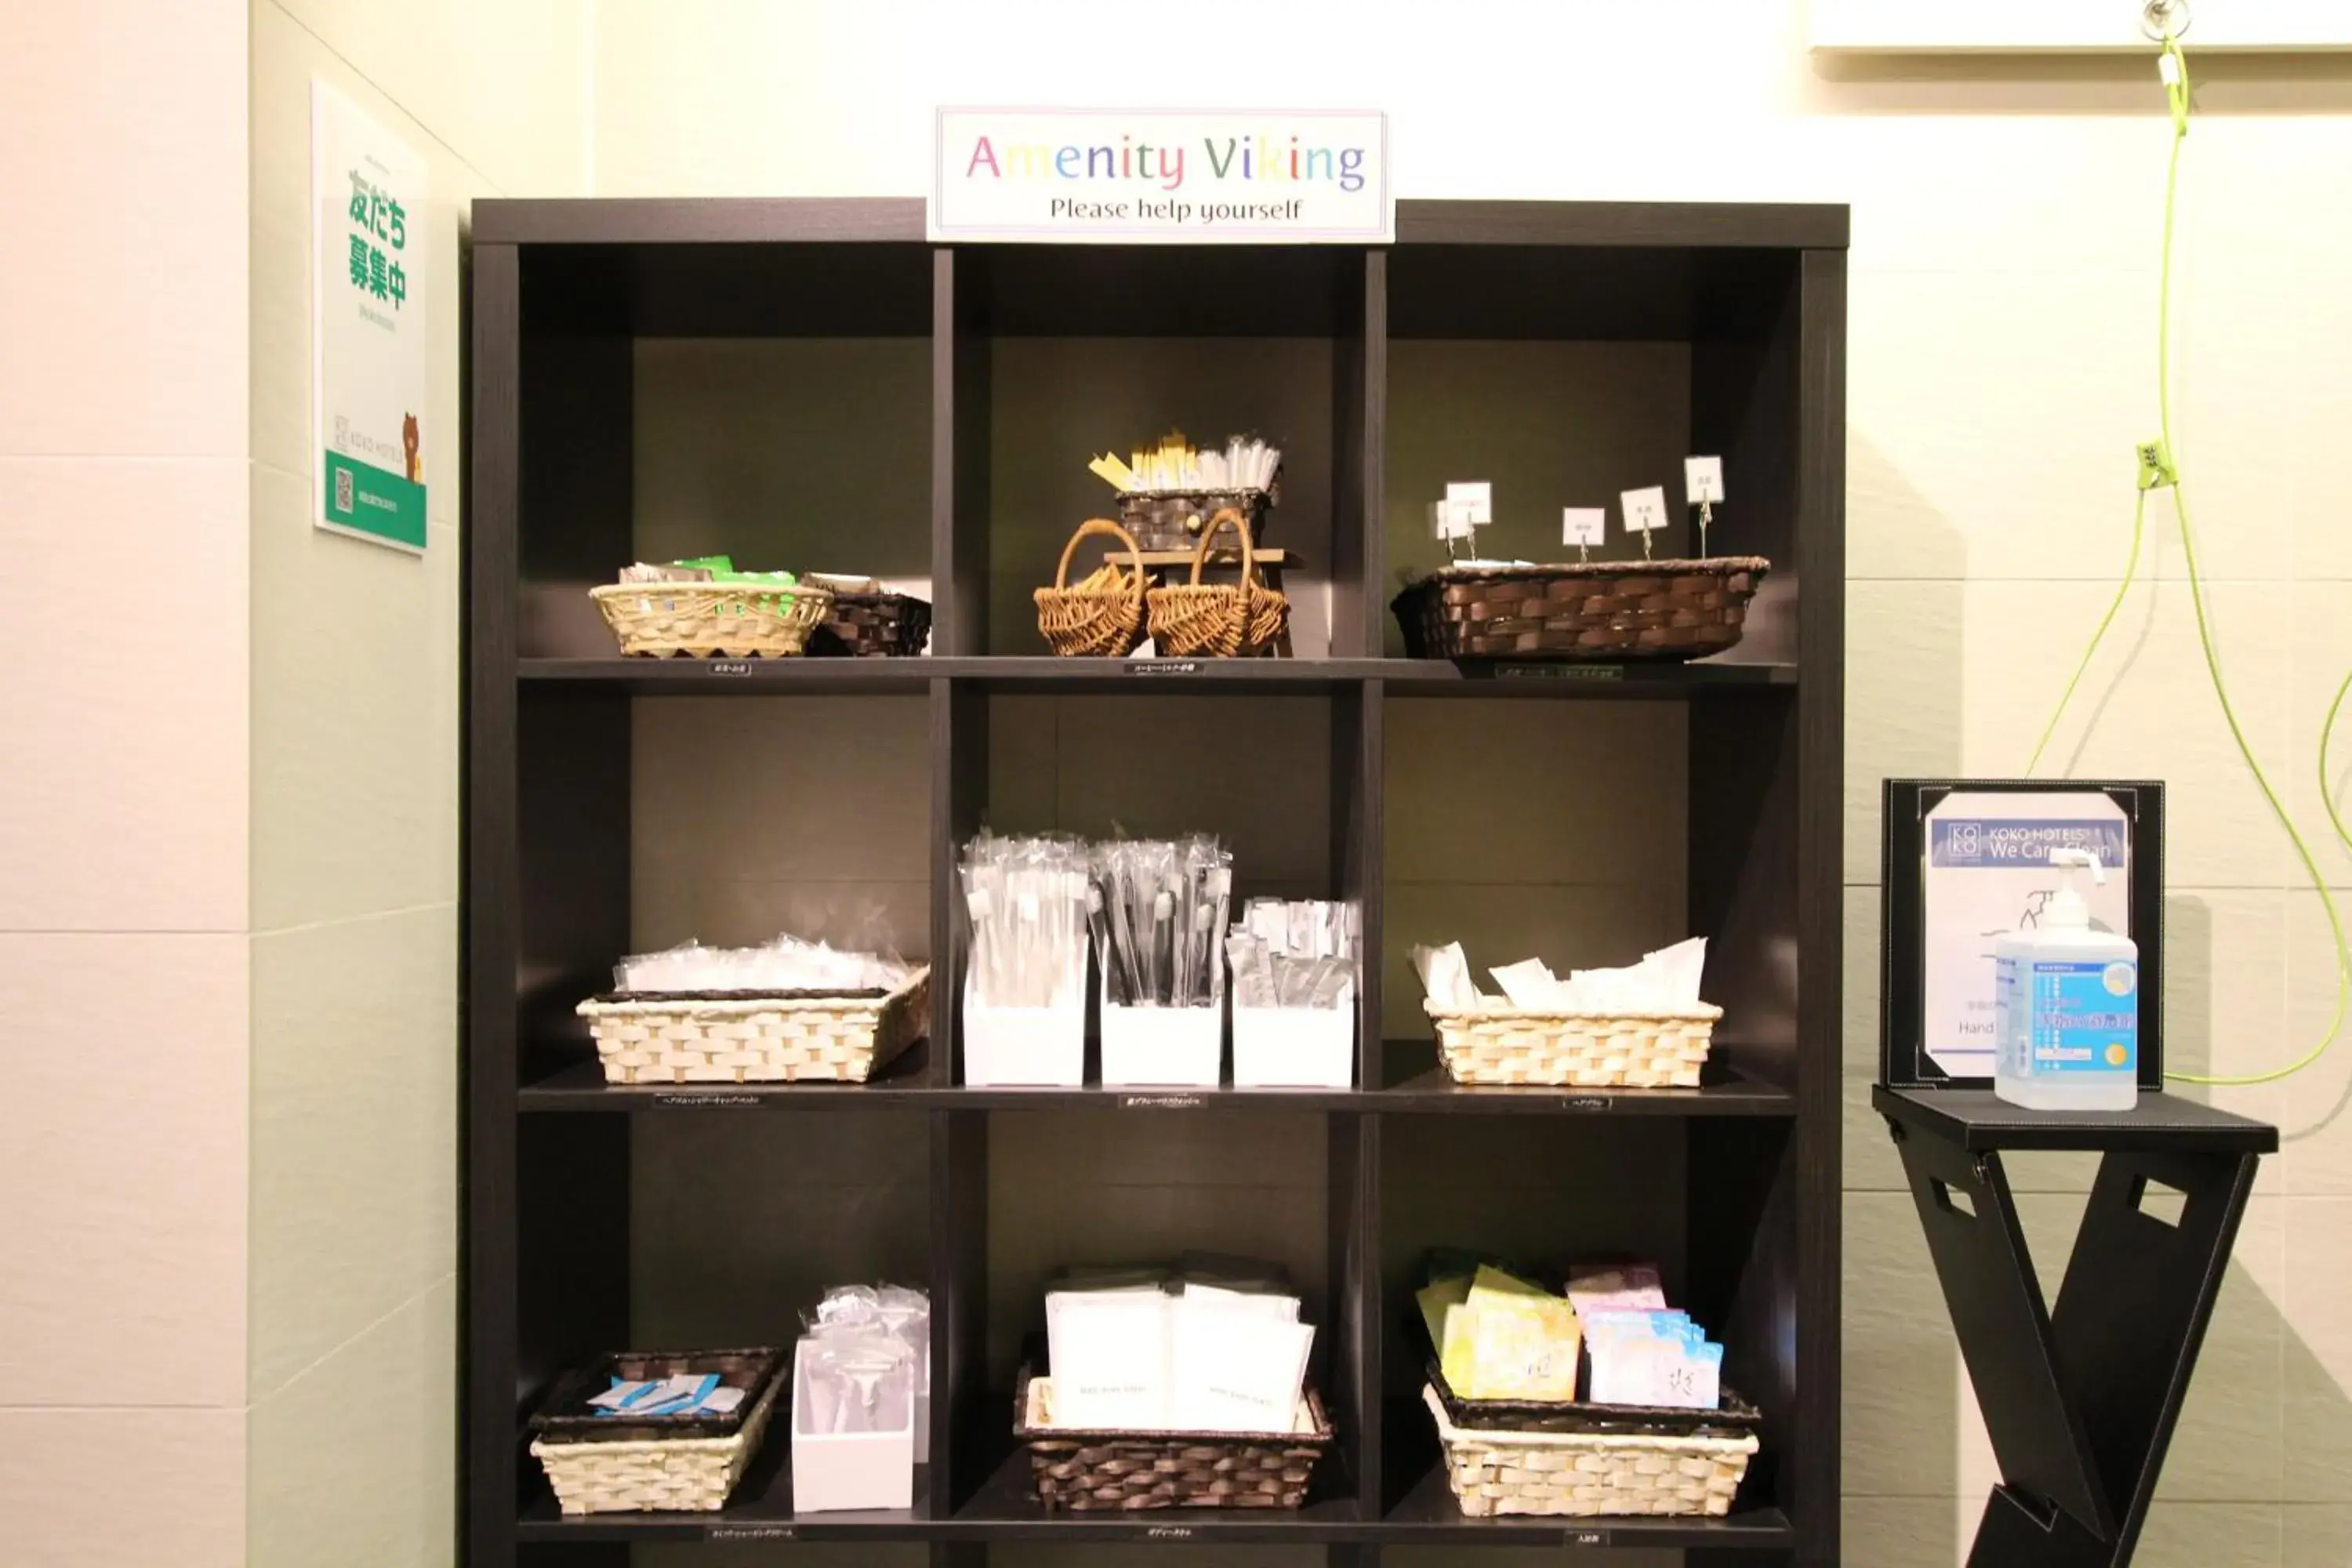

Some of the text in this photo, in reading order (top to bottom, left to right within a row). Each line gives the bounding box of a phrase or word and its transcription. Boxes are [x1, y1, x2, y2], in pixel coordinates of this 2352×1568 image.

[967, 134, 1366, 193] Amenity Viking
[349, 169, 405, 250] 友だち
[1051, 198, 1305, 224] Please help yourself
[349, 233, 405, 311] 募集中
[1989, 828, 2085, 841] KOKO HOTELS
[1989, 842, 2018, 858] We
[2021, 842, 2054, 859] Car
[1959, 1020, 1994, 1035] Hand
